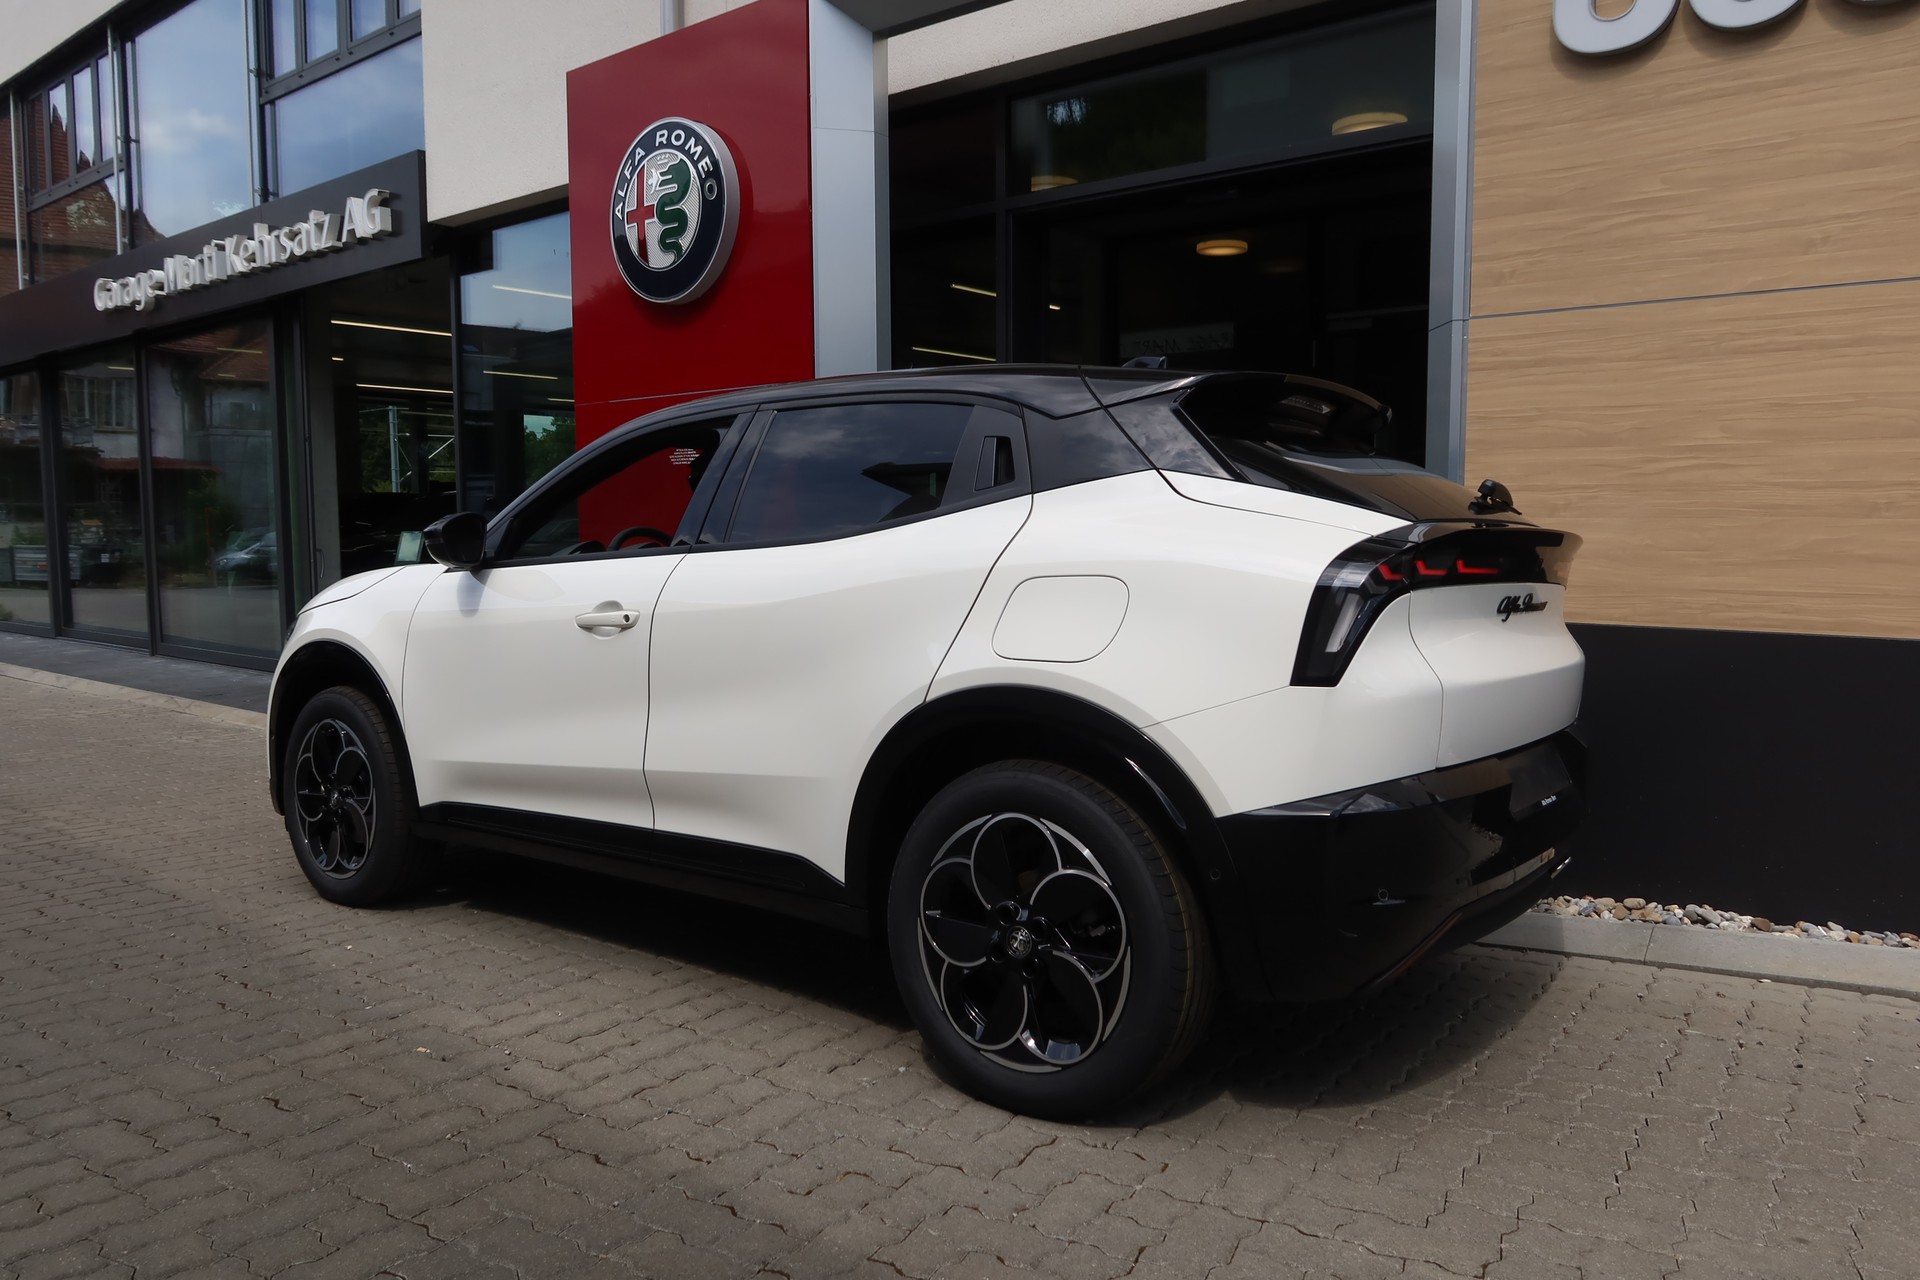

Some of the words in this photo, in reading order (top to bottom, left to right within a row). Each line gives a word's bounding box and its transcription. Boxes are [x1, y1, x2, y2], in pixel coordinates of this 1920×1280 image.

[615, 147, 646, 220] ALFA
[655, 129, 718, 201] ROMEO
[94, 269, 165, 311] Garage
[224, 210, 341, 276] Kehrsatz
[341, 188, 392, 243] AG
